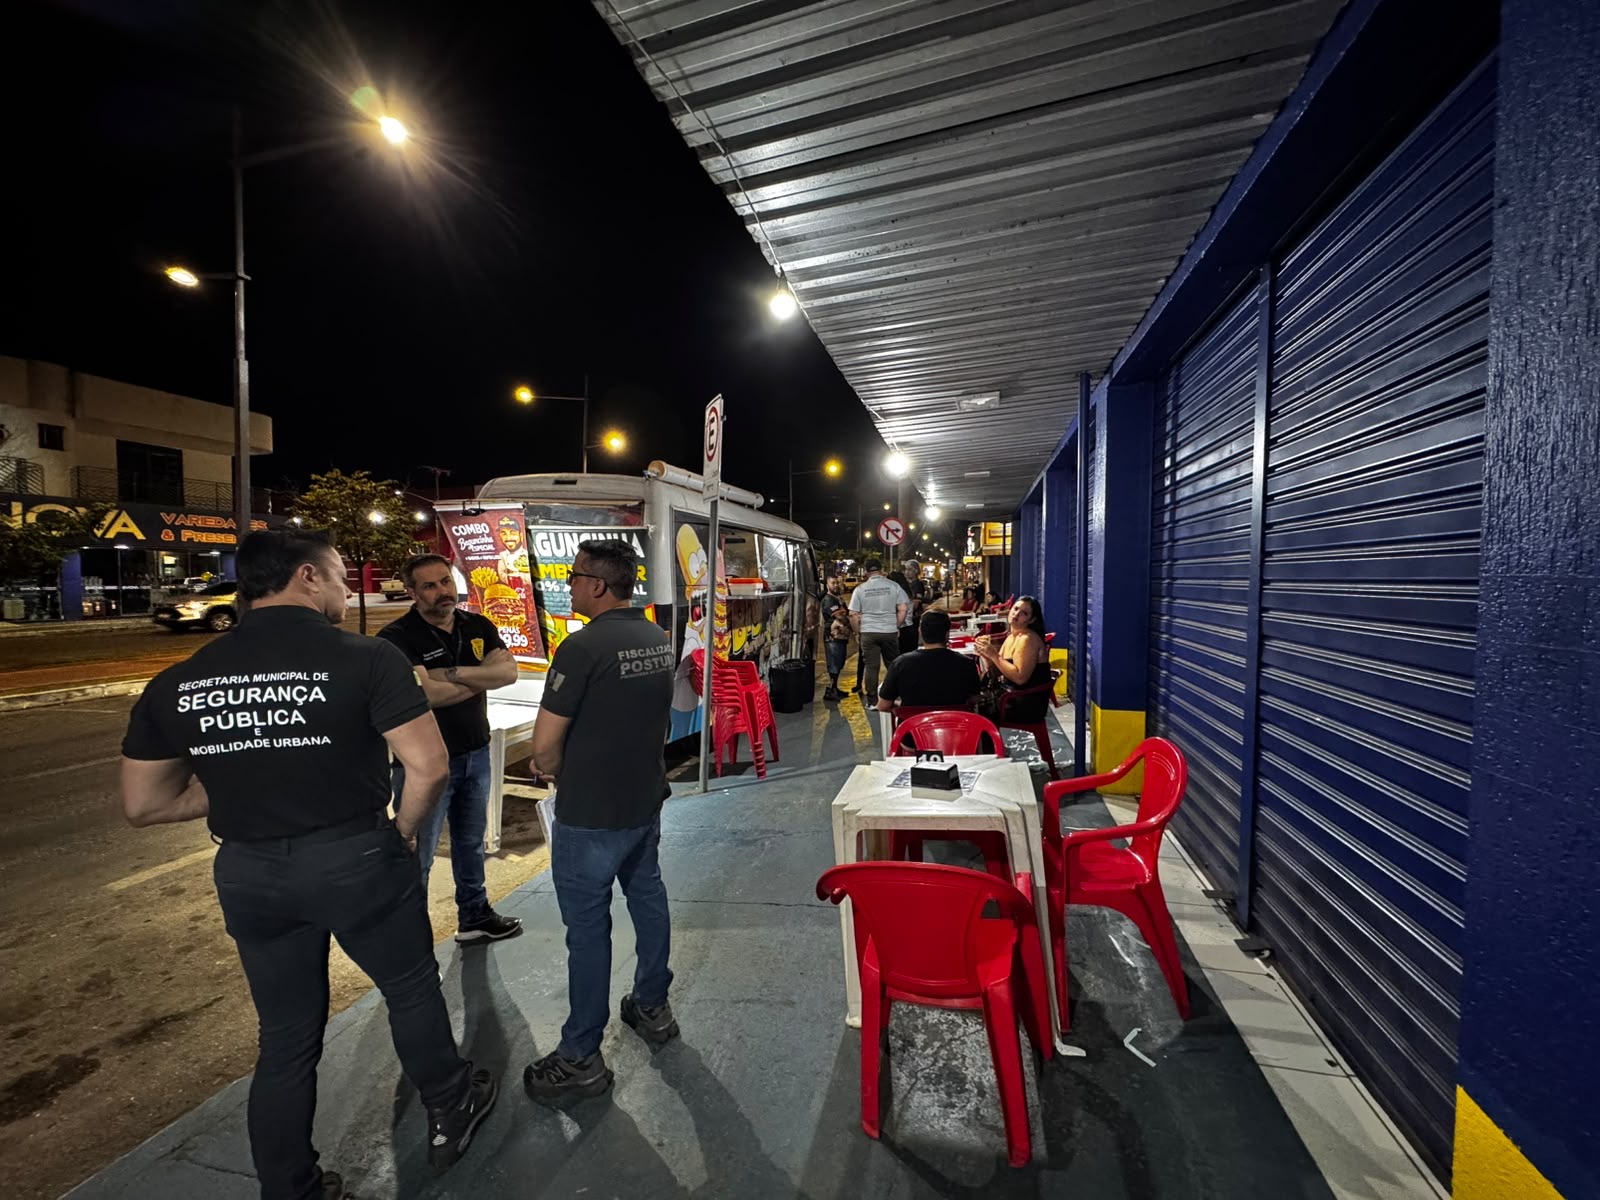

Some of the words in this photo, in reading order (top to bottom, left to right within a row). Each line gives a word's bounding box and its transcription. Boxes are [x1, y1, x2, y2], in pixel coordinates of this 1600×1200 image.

[708, 416, 716, 452] E
[160, 512, 268, 531] VARIEDAES
[452, 523, 490, 536] COMBO
[161, 528, 175, 541] &
[181, 529, 238, 544] PRESE
[498, 626, 521, 635] PENAS
[178, 675, 250, 692] SECRETARIA
[252, 671, 310, 683] MUNICIPAL
[313, 672, 329, 681] DE
[177, 685, 327, 713] SEGURANÇA
[200, 709, 307, 733] PÚBLICA
[254, 727, 262, 736] E
[189, 738, 271, 756] MOBILIDADE
[273, 736, 332, 748] URBANA
